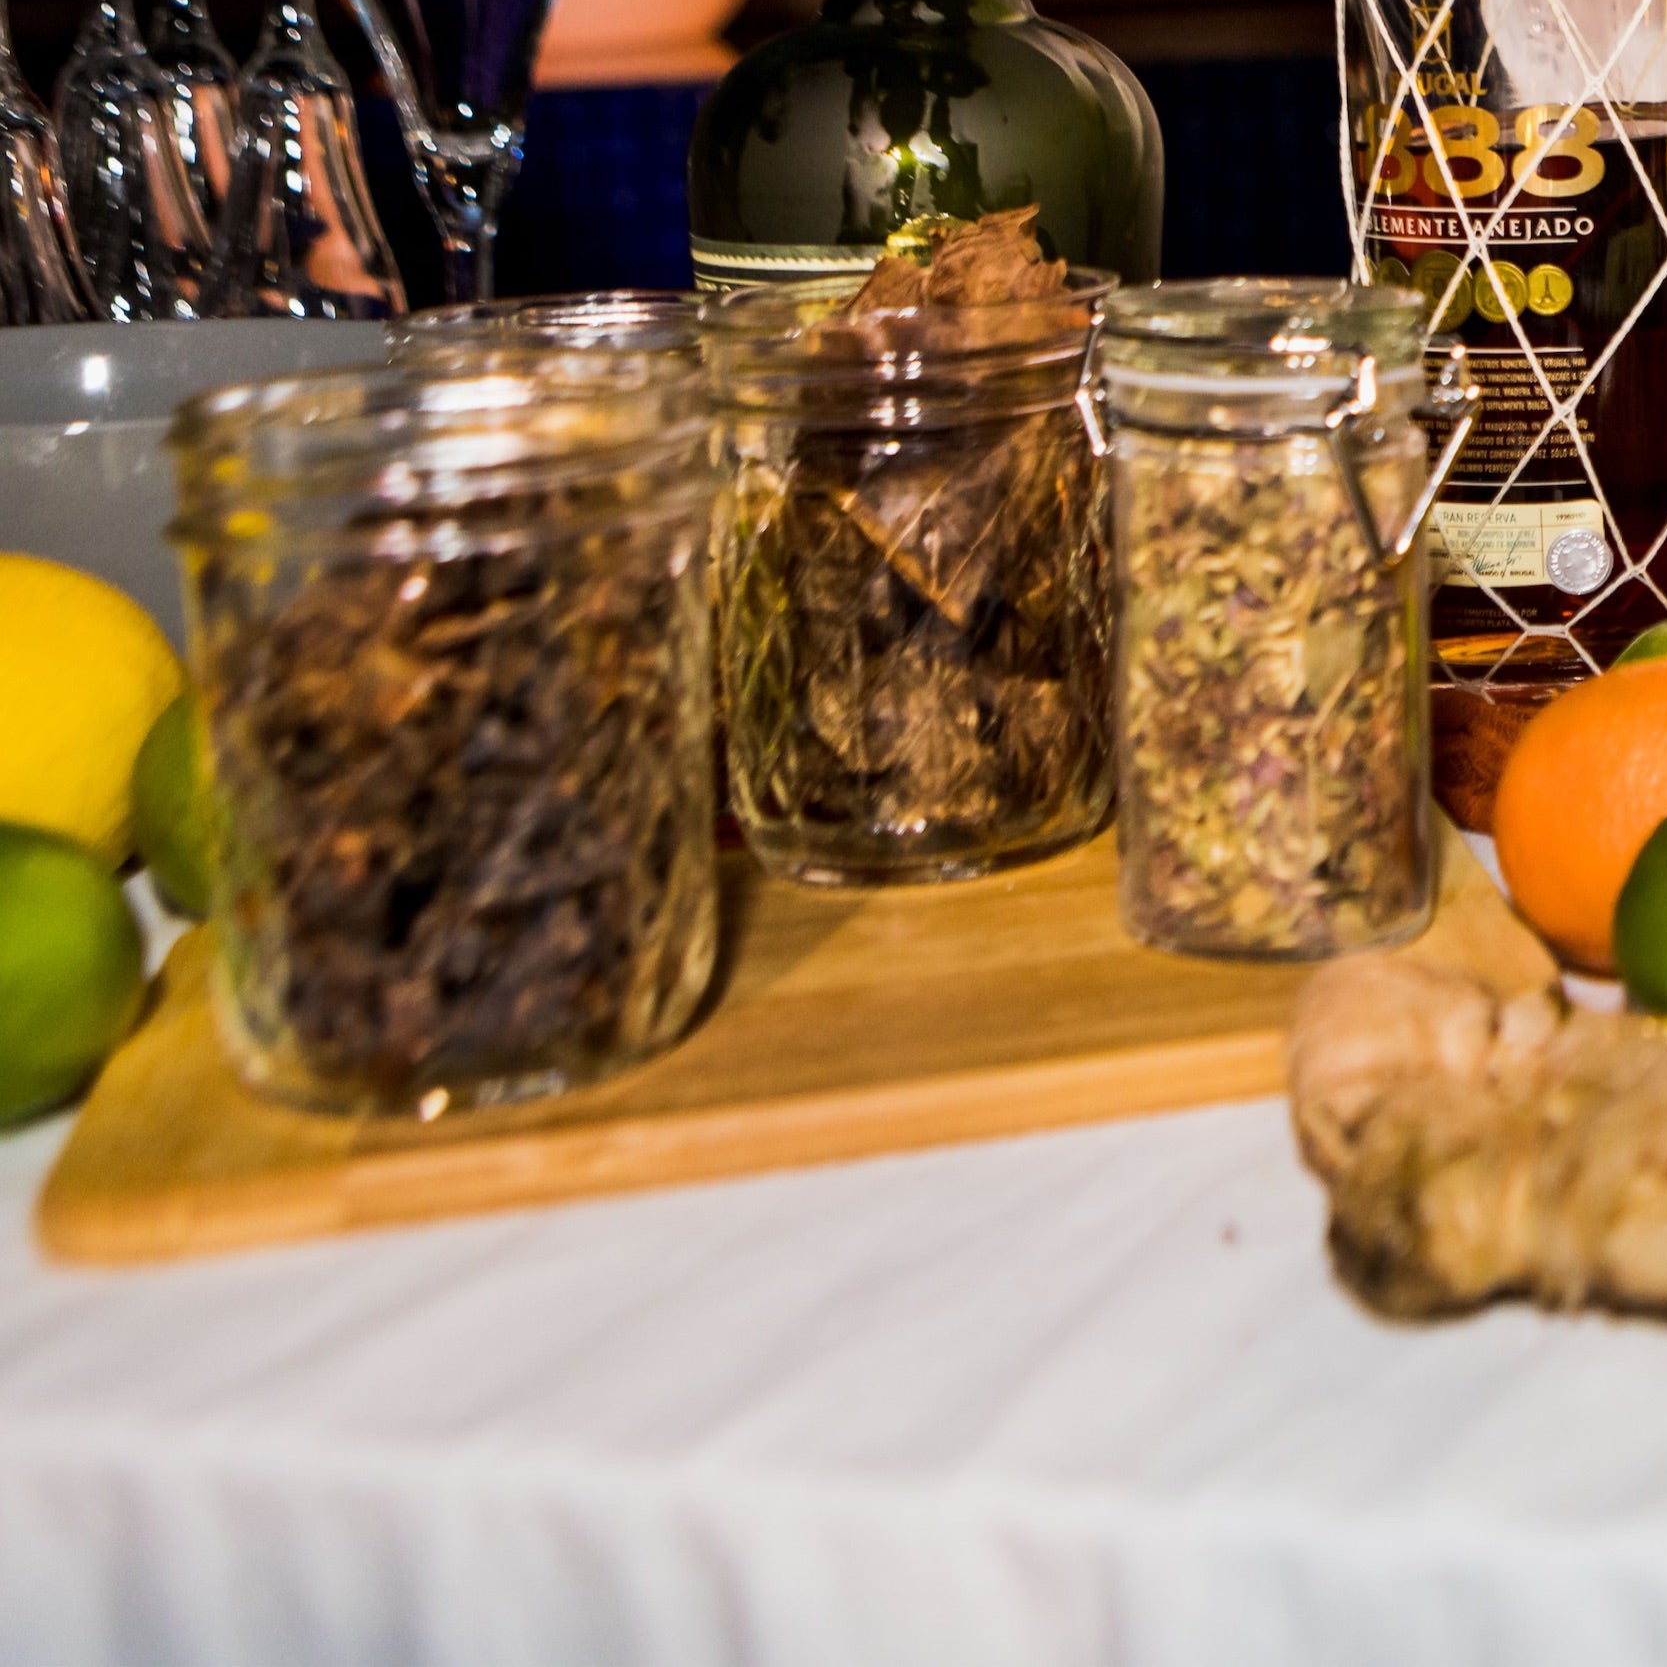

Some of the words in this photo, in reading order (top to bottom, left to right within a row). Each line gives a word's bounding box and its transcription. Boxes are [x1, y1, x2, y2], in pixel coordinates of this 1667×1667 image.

[1390, 72, 1487, 95] BUGAL
[1366, 215, 1459, 236] BLEMENTE
[1439, 511, 1463, 523] RAN
